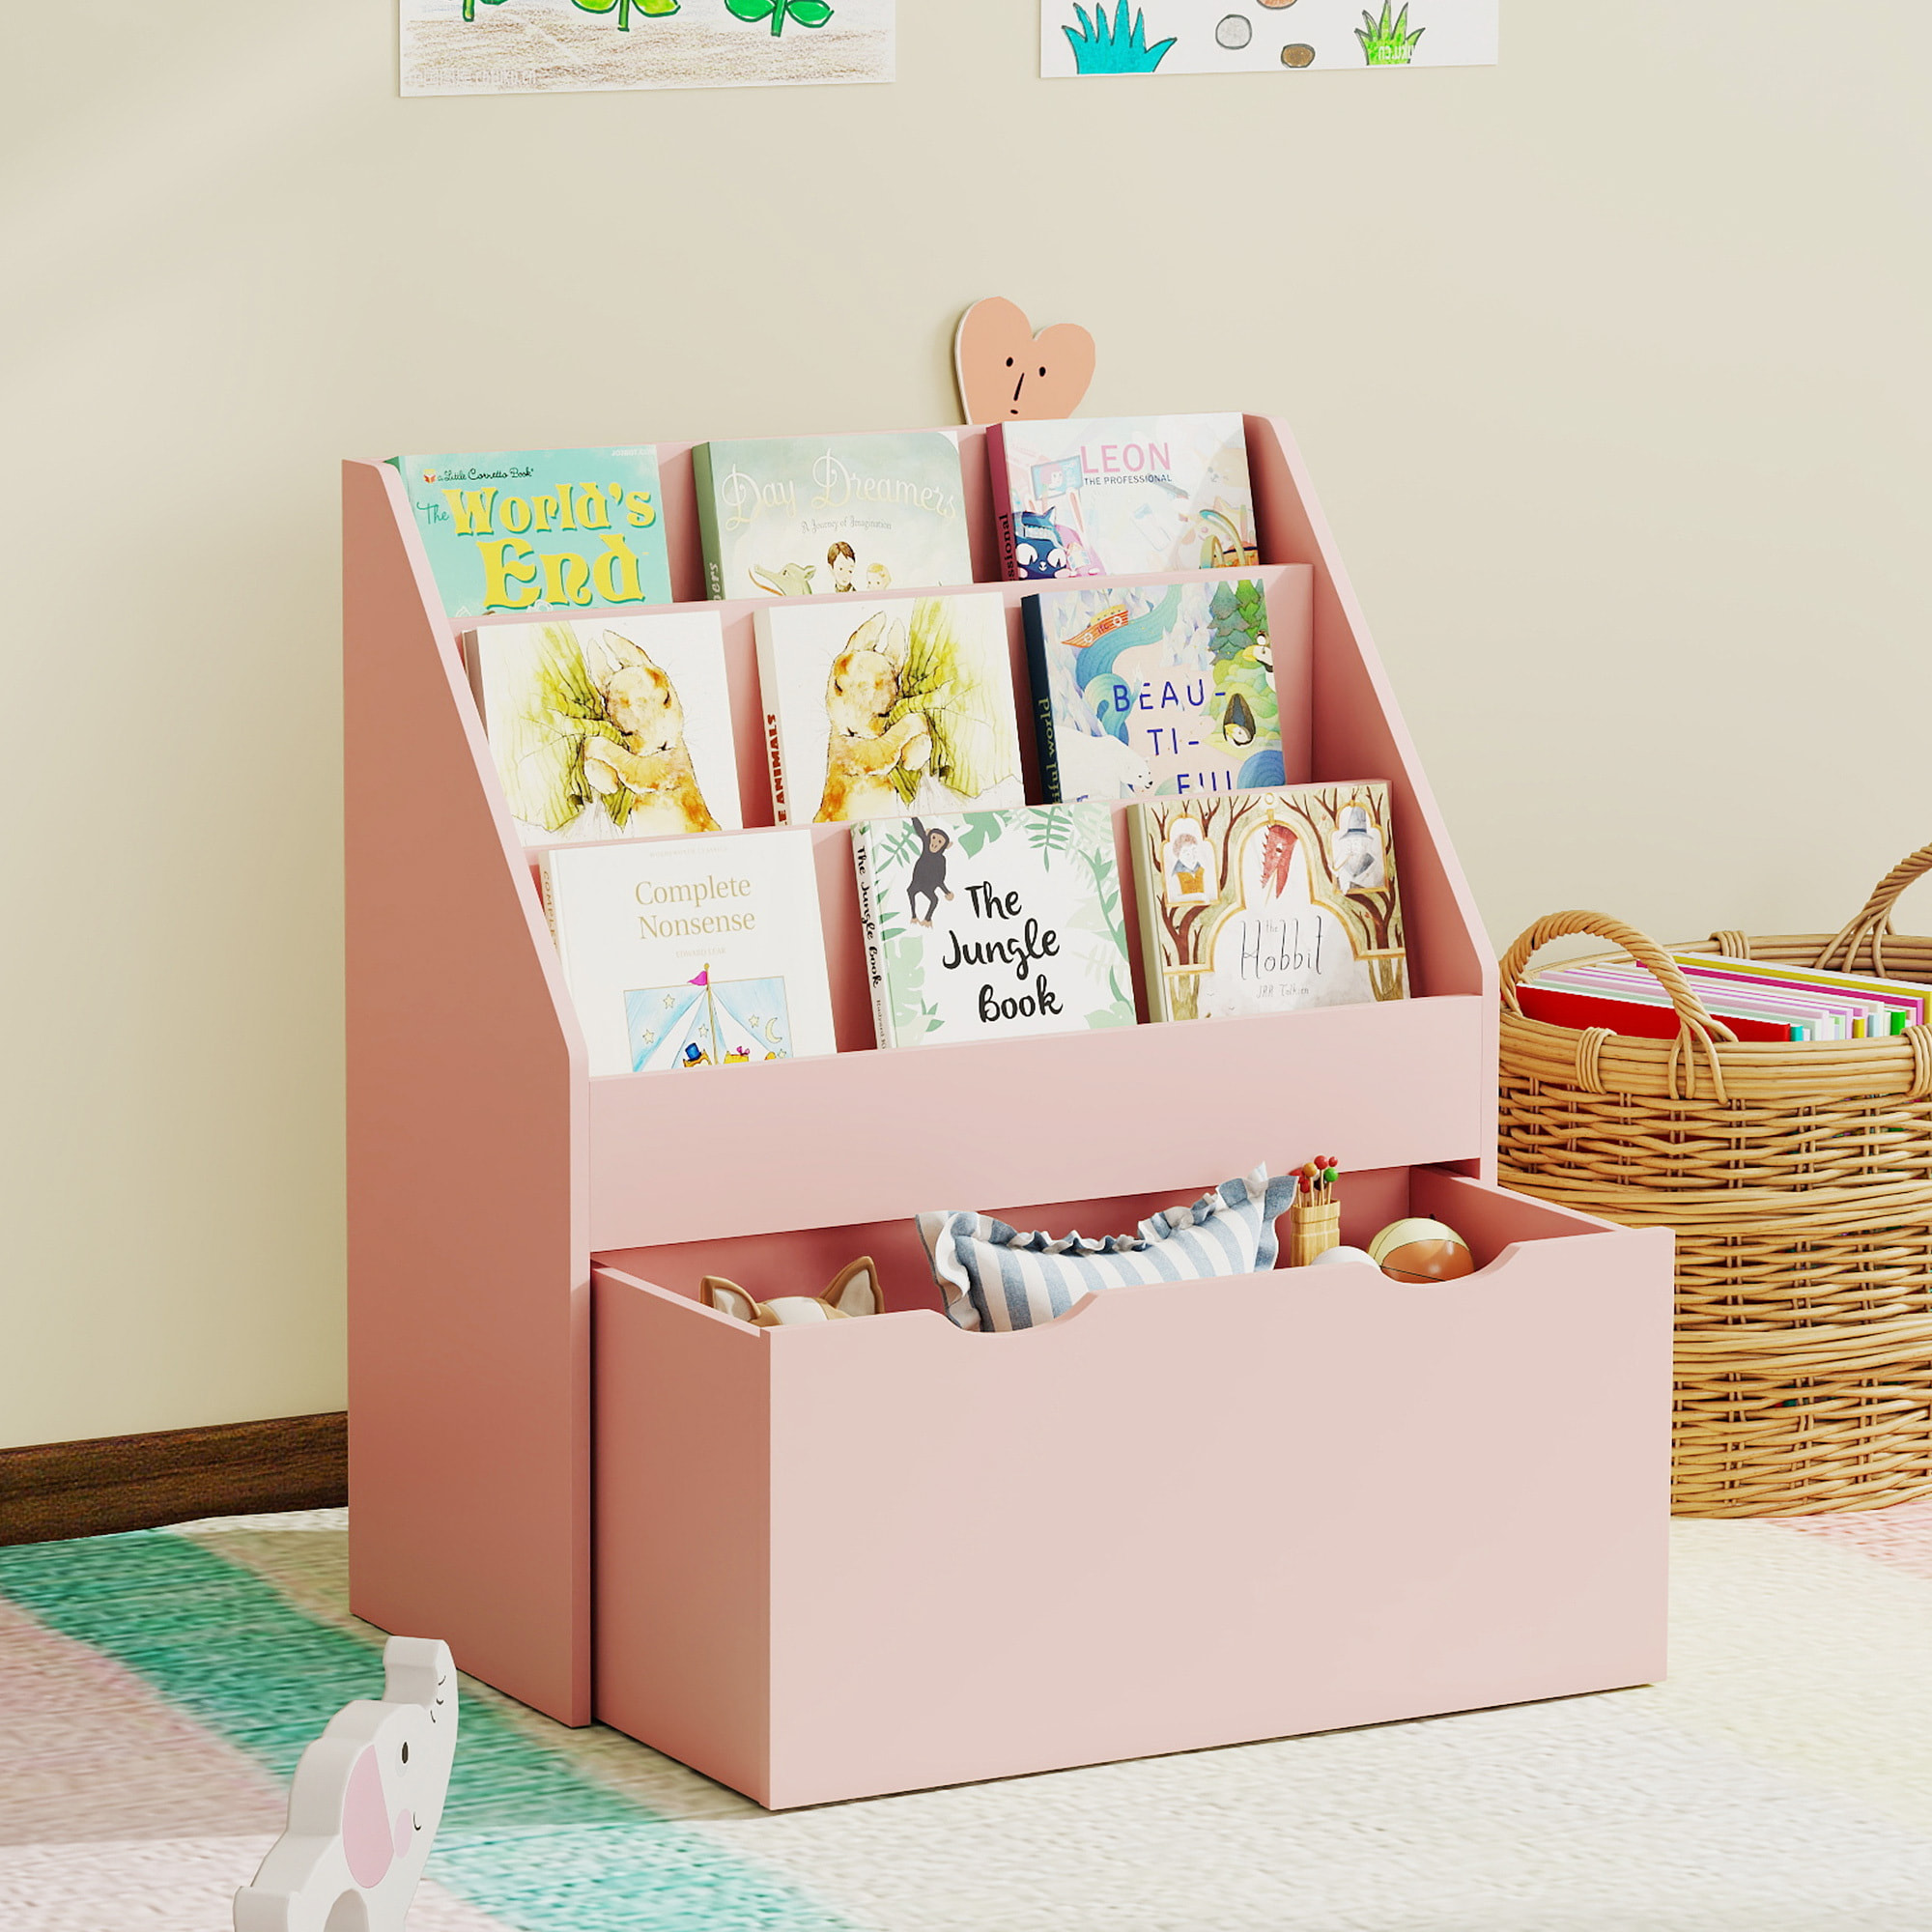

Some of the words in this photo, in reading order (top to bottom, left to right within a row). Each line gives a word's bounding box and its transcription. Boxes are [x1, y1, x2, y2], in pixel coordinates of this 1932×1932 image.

[1080, 442, 1171, 473] LEON
[722, 464, 797, 530] Day
[811, 448, 956, 519] Dreamers
[1084, 477, 1101, 486] THE
[1104, 474, 1172, 485] PROFESSIONAL
[416, 501, 449, 525] The
[440, 482, 656, 536] World's
[810, 518, 838, 533] Journey
[839, 516, 848, 527] of
[850, 515, 892, 531] Imagination
[475, 533, 645, 611] End
[1113, 679, 1226, 712] BEAU-
[768, 714, 785, 804] ANIMALS
[1147, 728, 1200, 755] TI-
[857, 846, 867, 875] The
[635, 875, 751, 907] Complete
[965, 881, 1022, 919] The
[638, 912, 755, 939] Nonsense
[861, 881, 875, 941] Jungle
[1264, 919, 1279, 933] the
[943, 918, 1061, 980] Jungle
[1240, 915, 1322, 980] Hobbit
[868, 946, 882, 988] Book
[979, 974, 1063, 1022] Book
